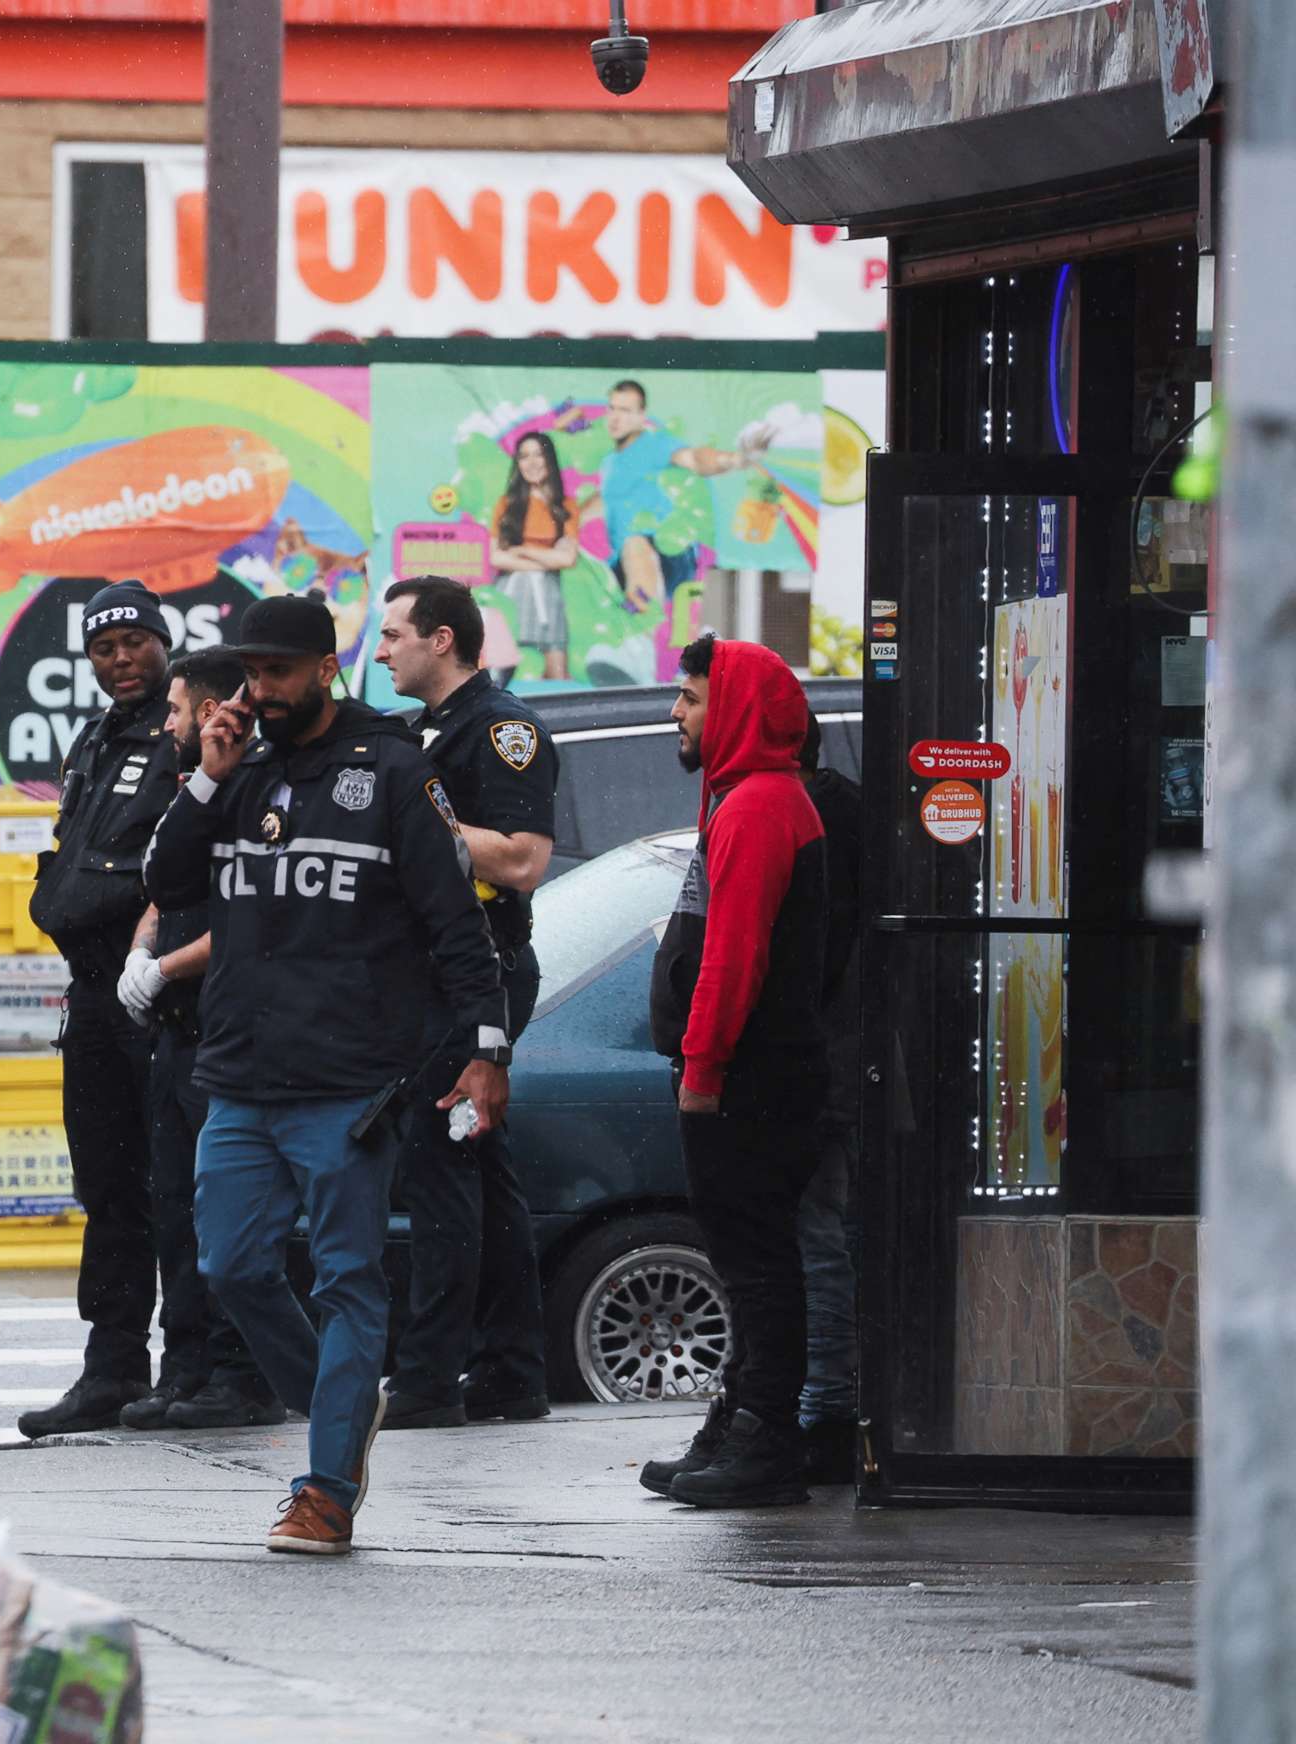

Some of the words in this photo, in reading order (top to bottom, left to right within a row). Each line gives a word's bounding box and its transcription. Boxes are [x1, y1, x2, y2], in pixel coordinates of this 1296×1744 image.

[31, 467, 253, 545] nickelodeon
[87, 606, 138, 631] NYPD
[873, 646, 896, 656] VISA
[929, 746, 943, 754] We
[944, 747, 971, 755] deliver
[973, 747, 991, 756] with
[939, 758, 1002, 768] DOORDASH
[931, 793, 975, 801] DELIVERED
[940, 808, 982, 819] GRUBHUB
